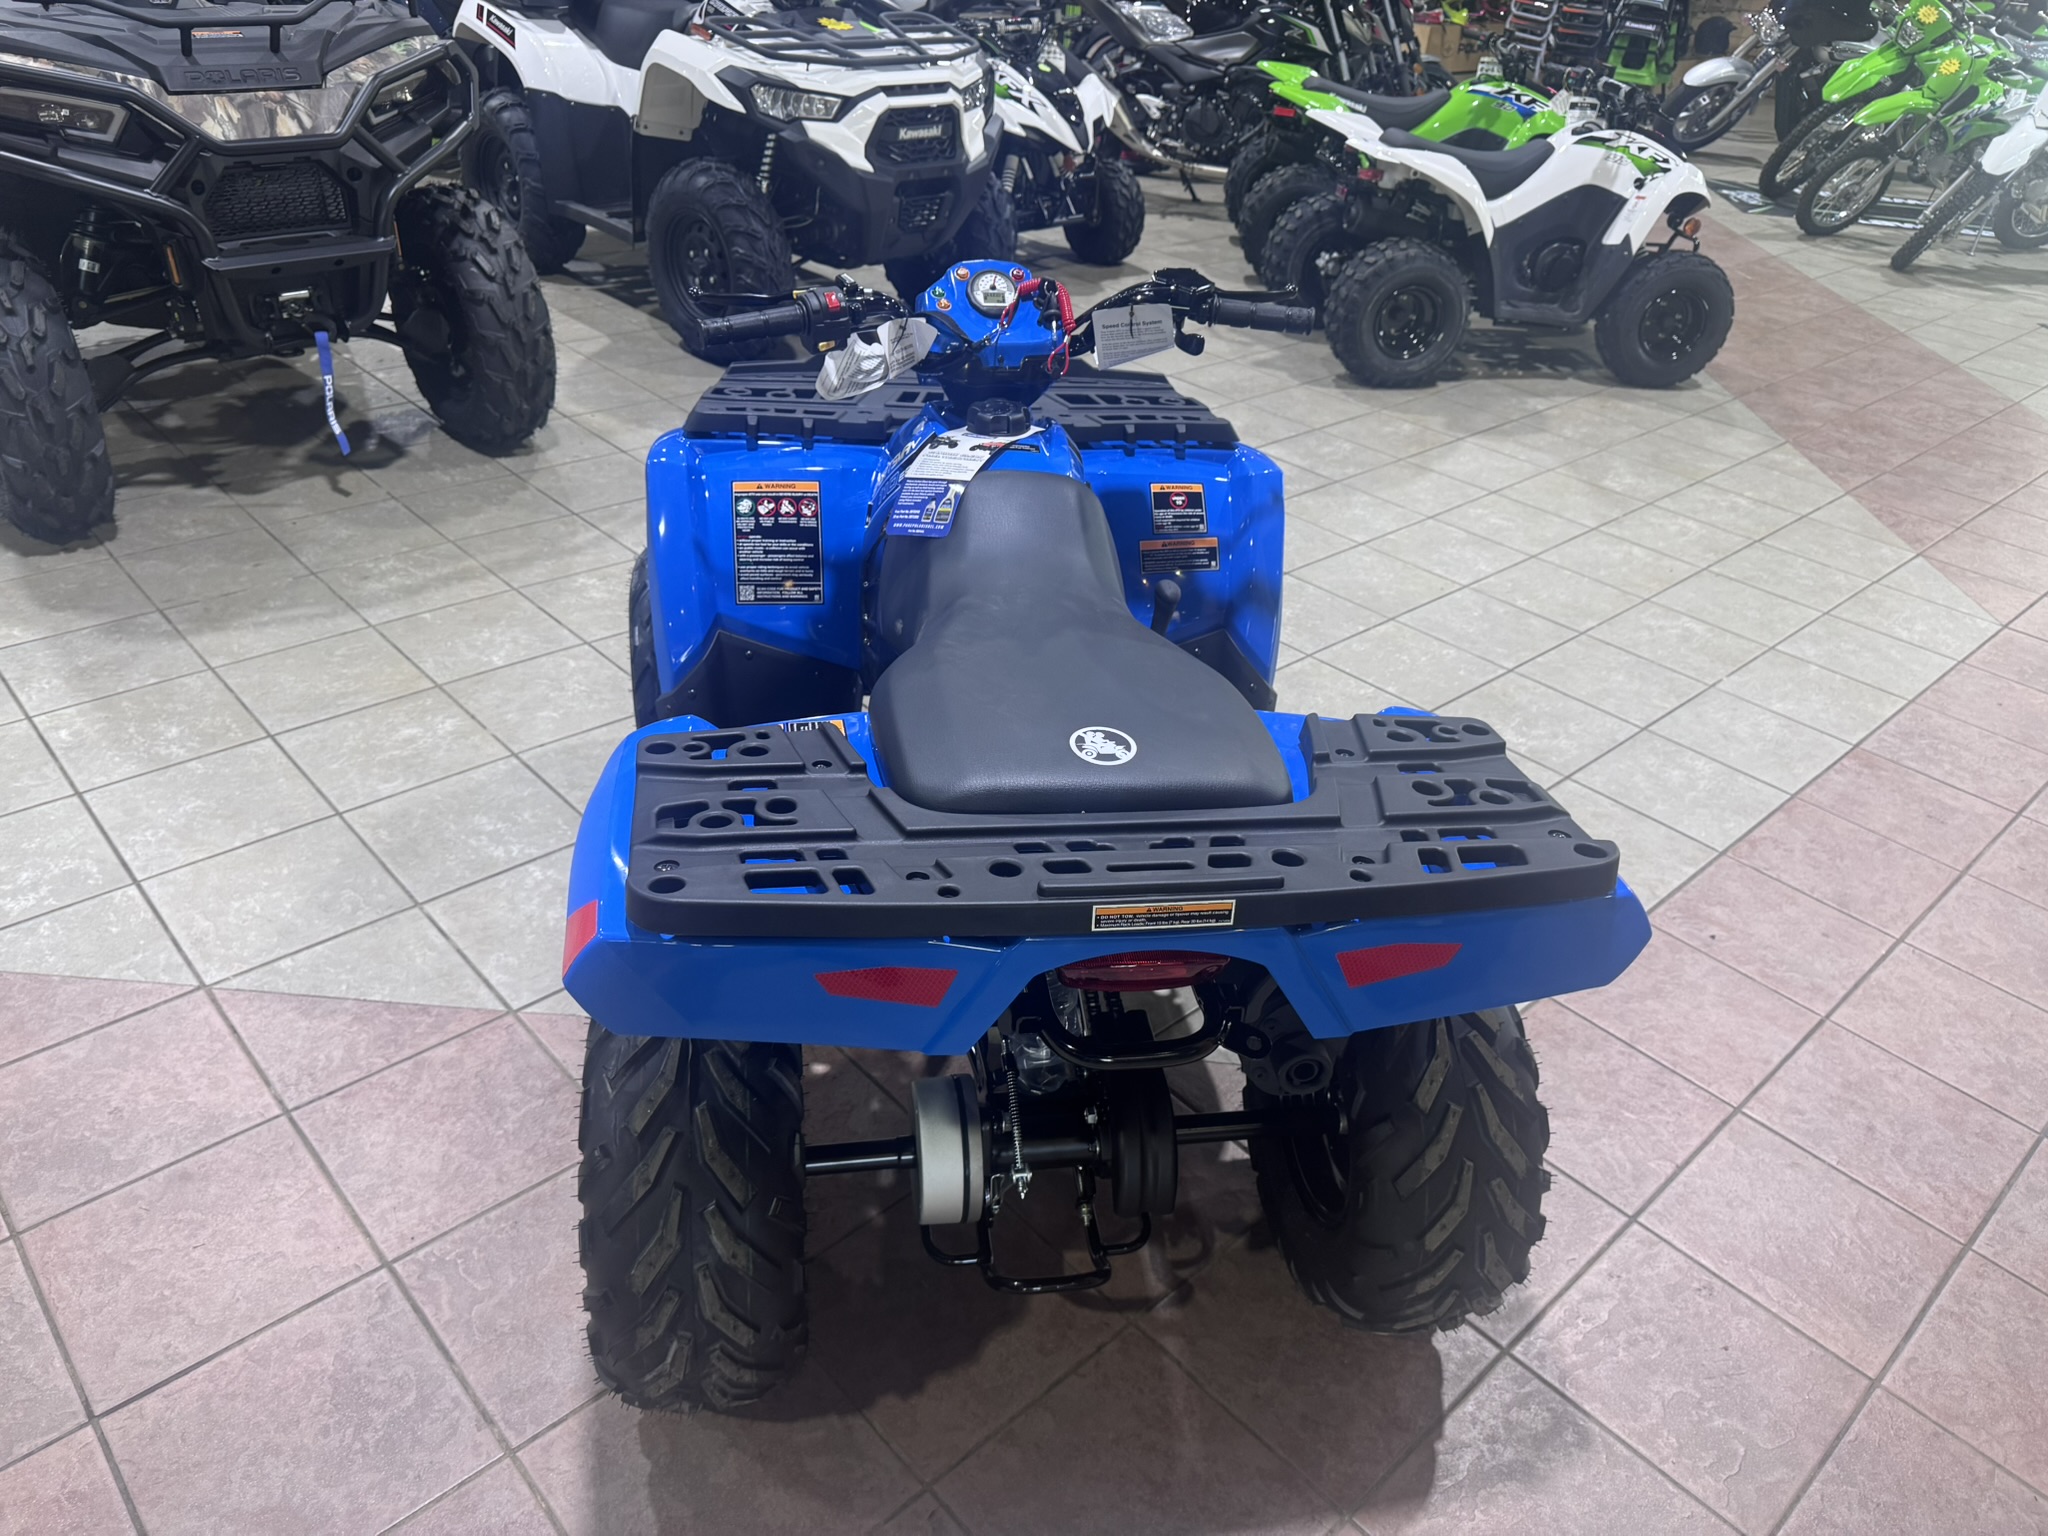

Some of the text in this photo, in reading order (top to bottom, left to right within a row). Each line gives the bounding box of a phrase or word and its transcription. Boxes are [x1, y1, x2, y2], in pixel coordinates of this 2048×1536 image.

[489, 14, 513, 36] Kawasaki
[1625, 20, 1657, 31] Kawasaki
[184, 67, 302, 84] POLARIS
[899, 124, 942, 140] Kawasaki
[323, 374, 342, 435] POLARIS
